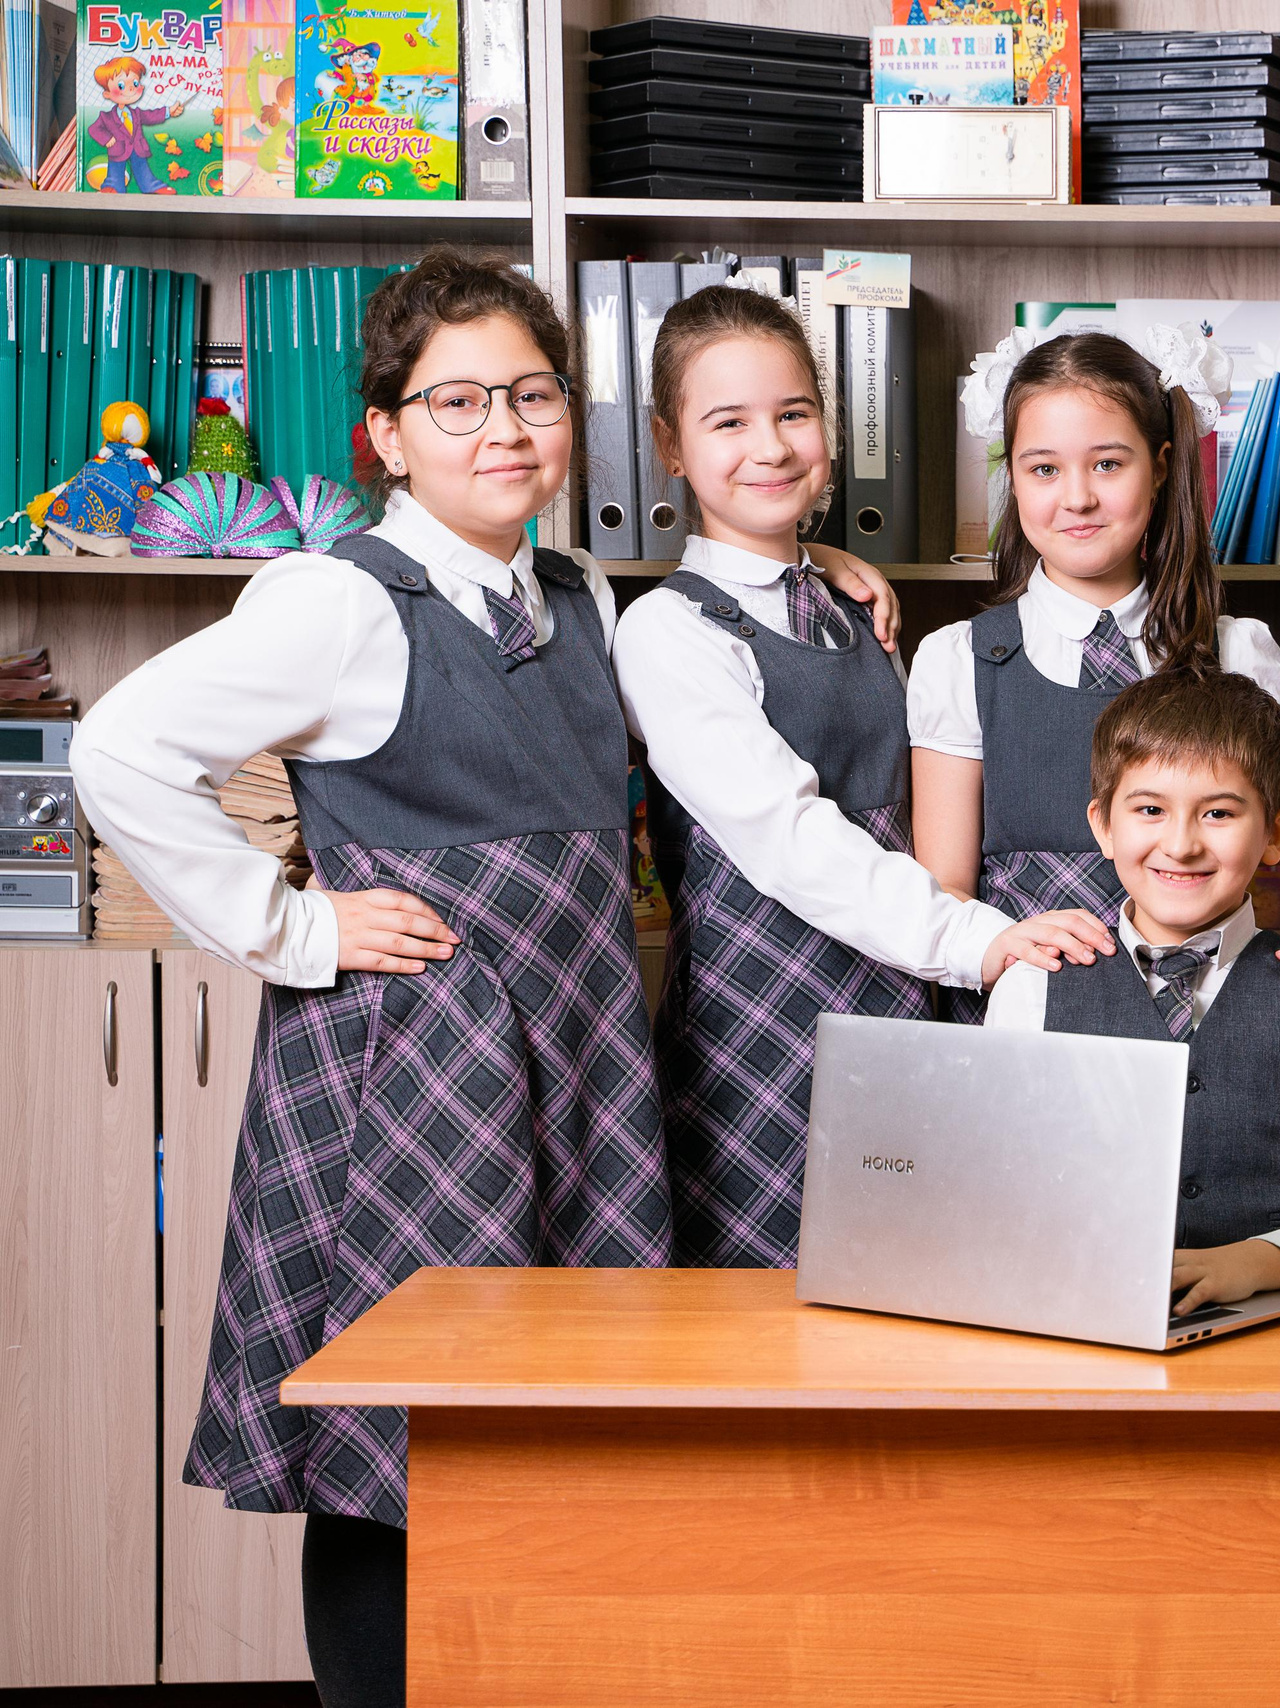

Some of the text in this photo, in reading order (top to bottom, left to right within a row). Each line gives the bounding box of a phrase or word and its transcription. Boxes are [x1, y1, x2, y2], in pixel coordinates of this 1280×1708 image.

[364, 8, 407, 20] Житков
[879, 33, 1007, 56] ШАХМАТНЫЙ
[150, 55, 209, 68] МА-МА
[880, 62, 939, 70] УЧЕБНИК
[965, 60, 1007, 70] ДЕТЕЙ
[154, 73, 187, 95] О-СА
[184, 82, 223, 97] ЛУ-НА
[312, 99, 416, 136] Рассказы
[324, 134, 433, 163] и сказки
[846, 285, 904, 295] ПРЕДСЕДАТЕЛЬ
[857, 293, 904, 303] ПРОФКОМА
[864, 357, 879, 457] профсоюзный
[862, 1155, 914, 1174] HONOR
